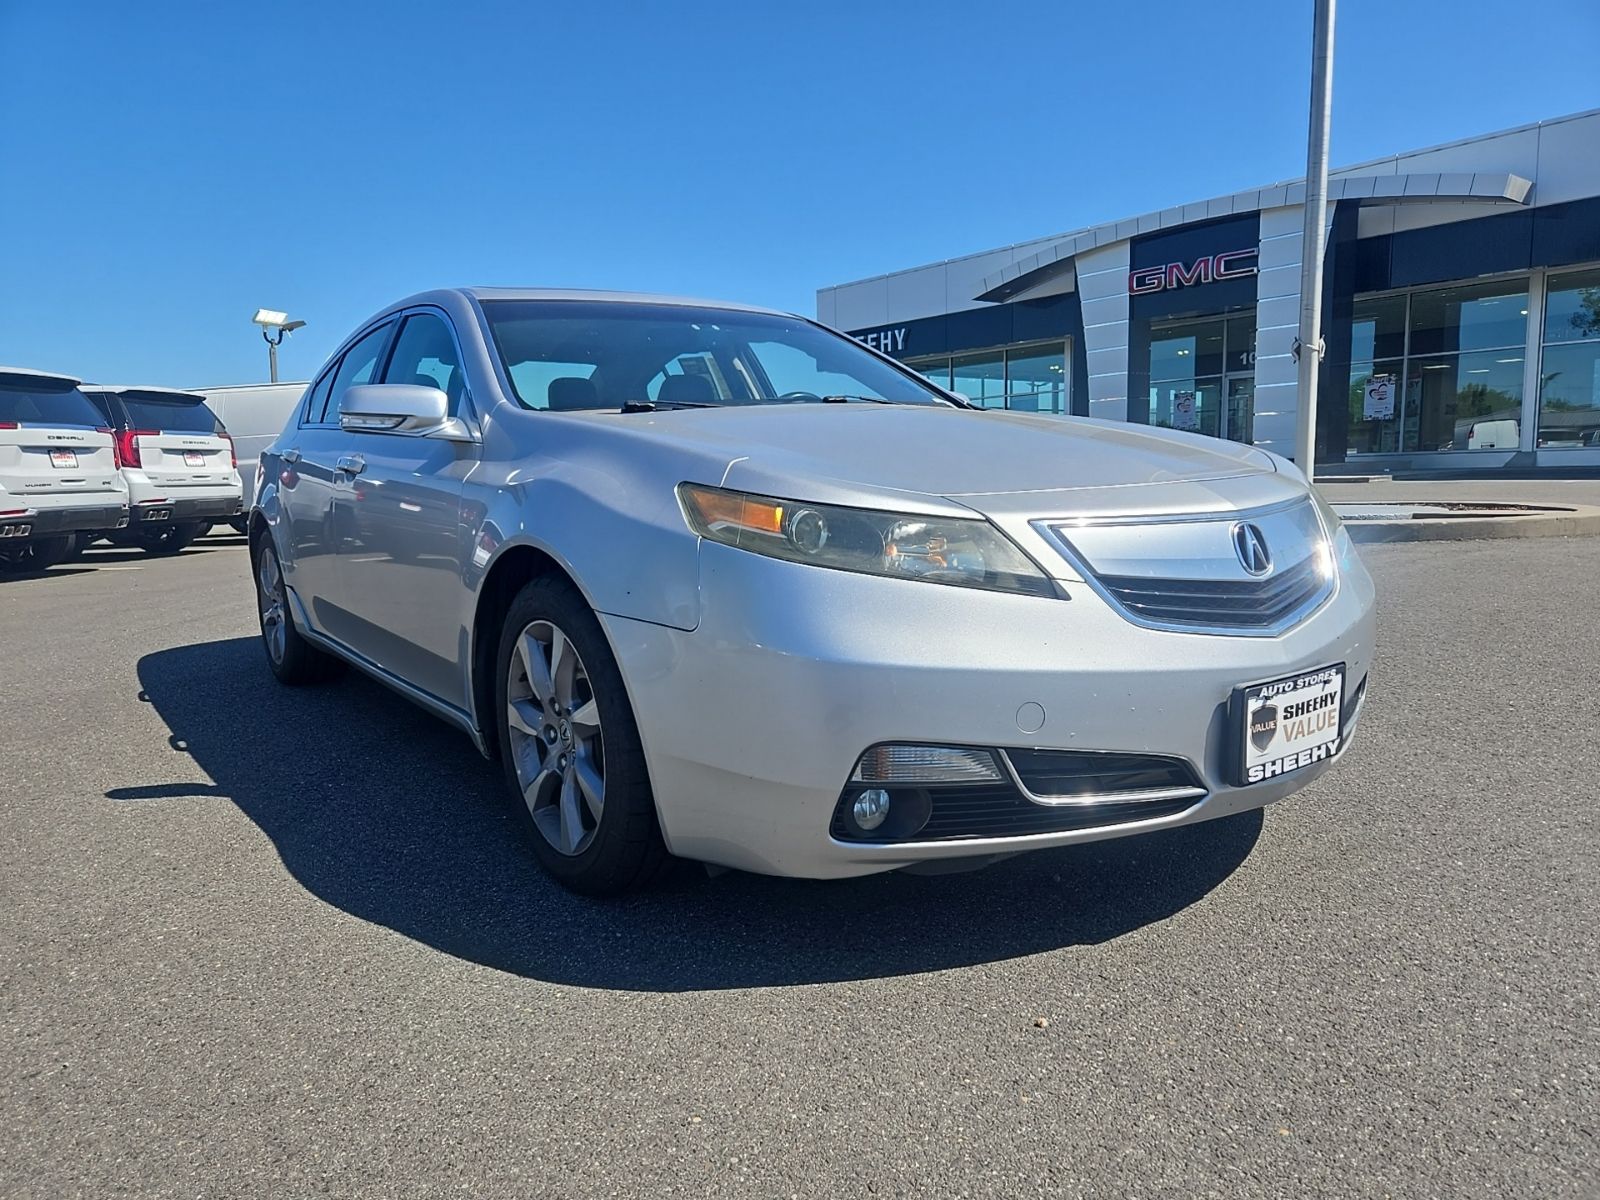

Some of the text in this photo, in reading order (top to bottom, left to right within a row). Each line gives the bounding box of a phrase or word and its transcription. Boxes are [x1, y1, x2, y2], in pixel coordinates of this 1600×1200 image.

[1128, 247, 1258, 295] GMC
[854, 328, 906, 353] EHY
[1259, 668, 1338, 698] AUTO STORES
[1282, 690, 1338, 721] SHEEHY
[1250, 719, 1276, 734] VALUE
[1282, 708, 1338, 743] VALUE
[1247, 738, 1341, 783] SHEEHY
